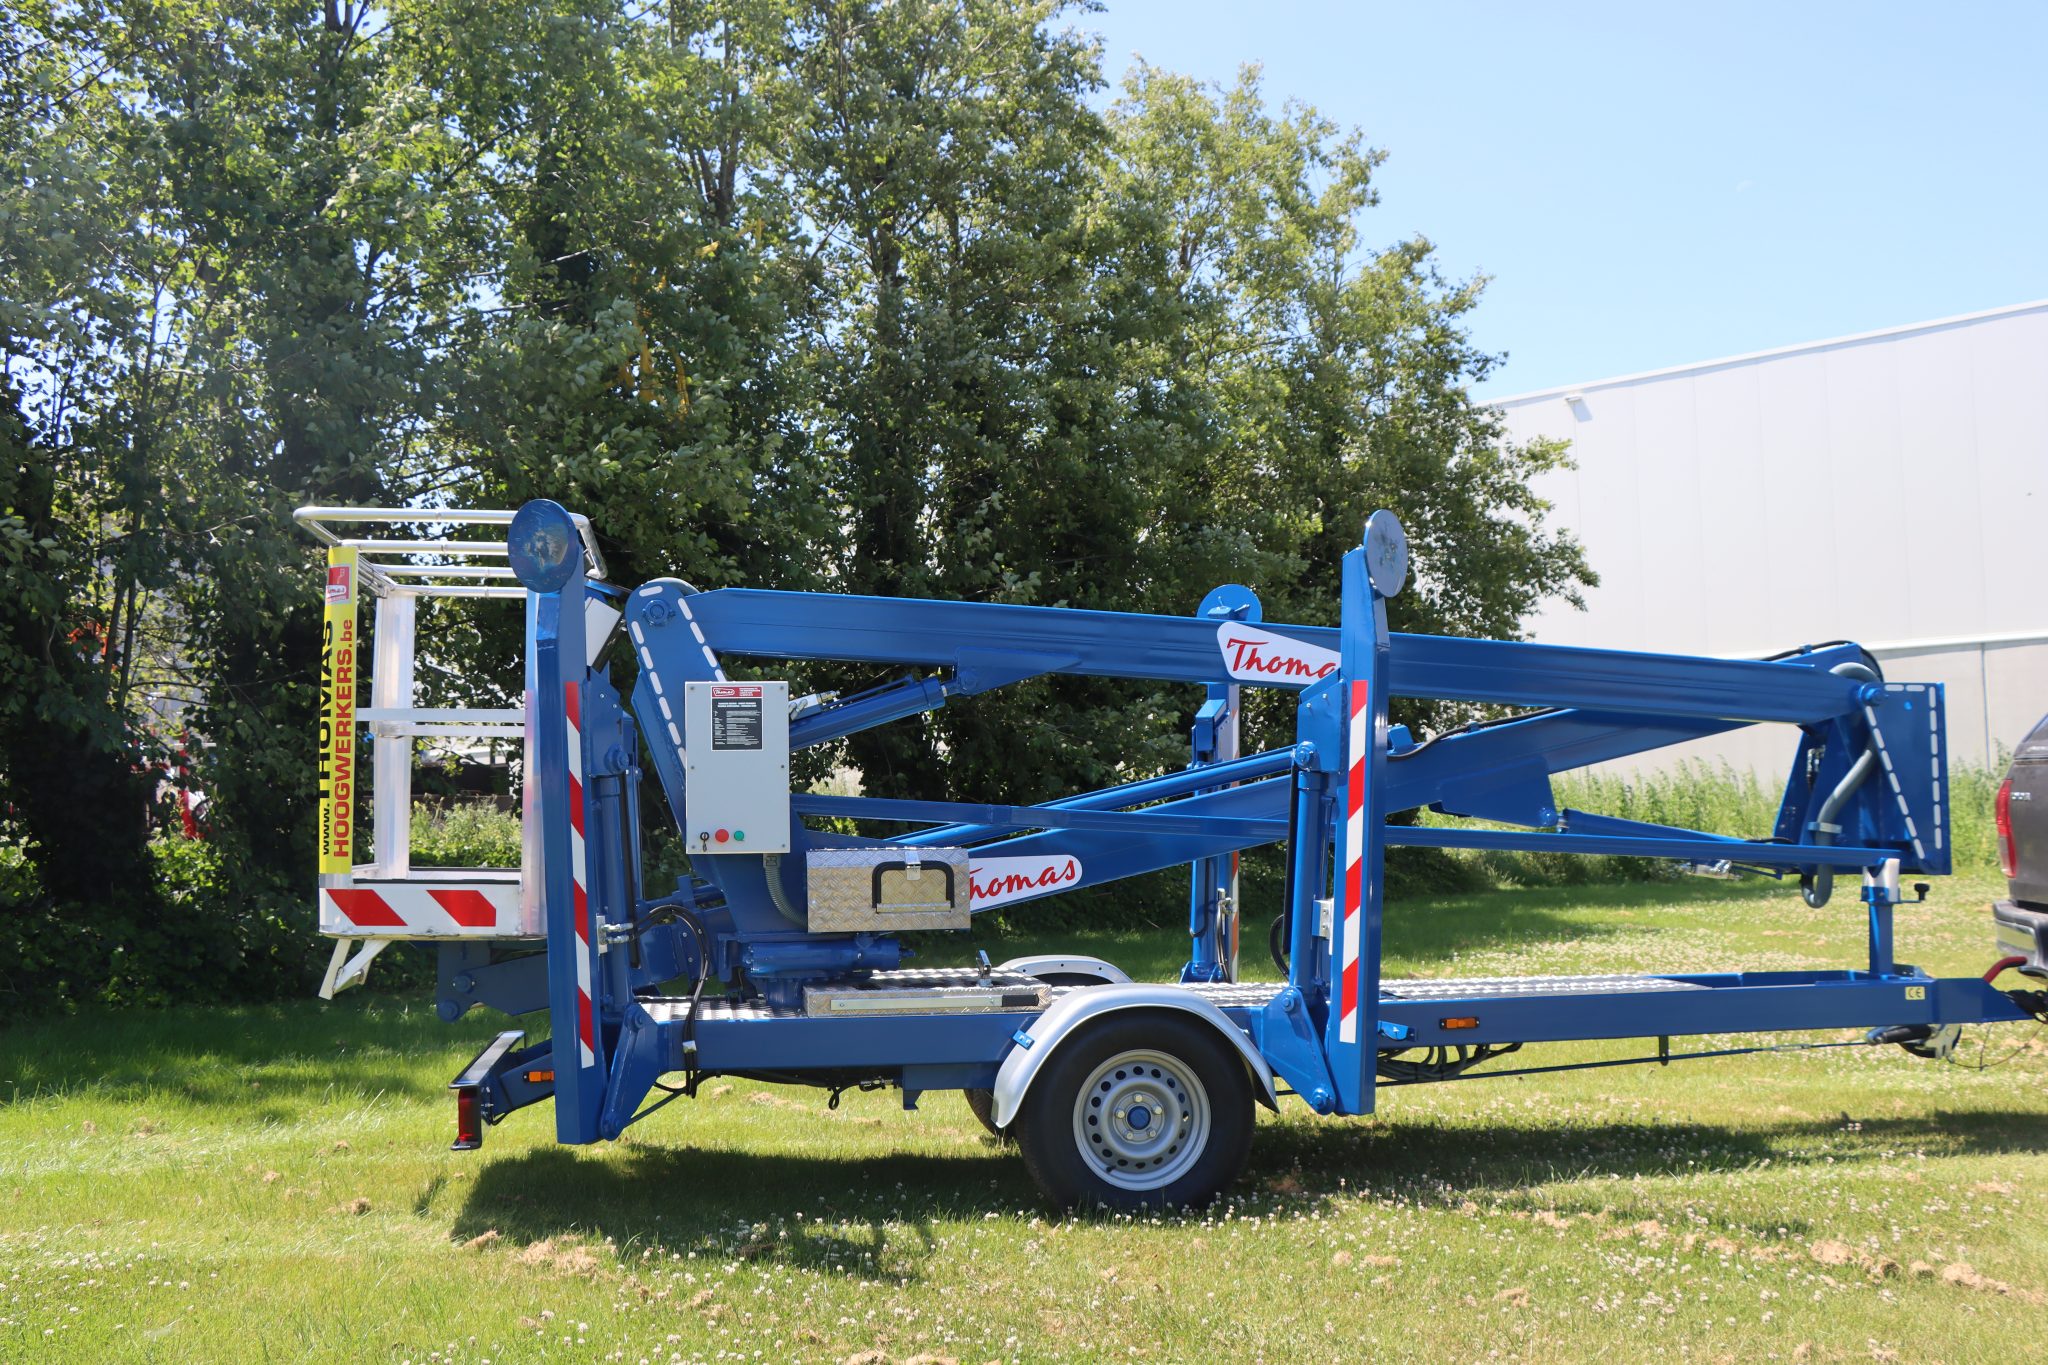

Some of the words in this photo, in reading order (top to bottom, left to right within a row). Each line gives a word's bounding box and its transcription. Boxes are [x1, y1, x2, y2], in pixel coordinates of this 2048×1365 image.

[1227, 638, 1337, 679] Thoma
[333, 619, 353, 857] HOOGWERKERS.be
[969, 860, 1076, 900] homas
